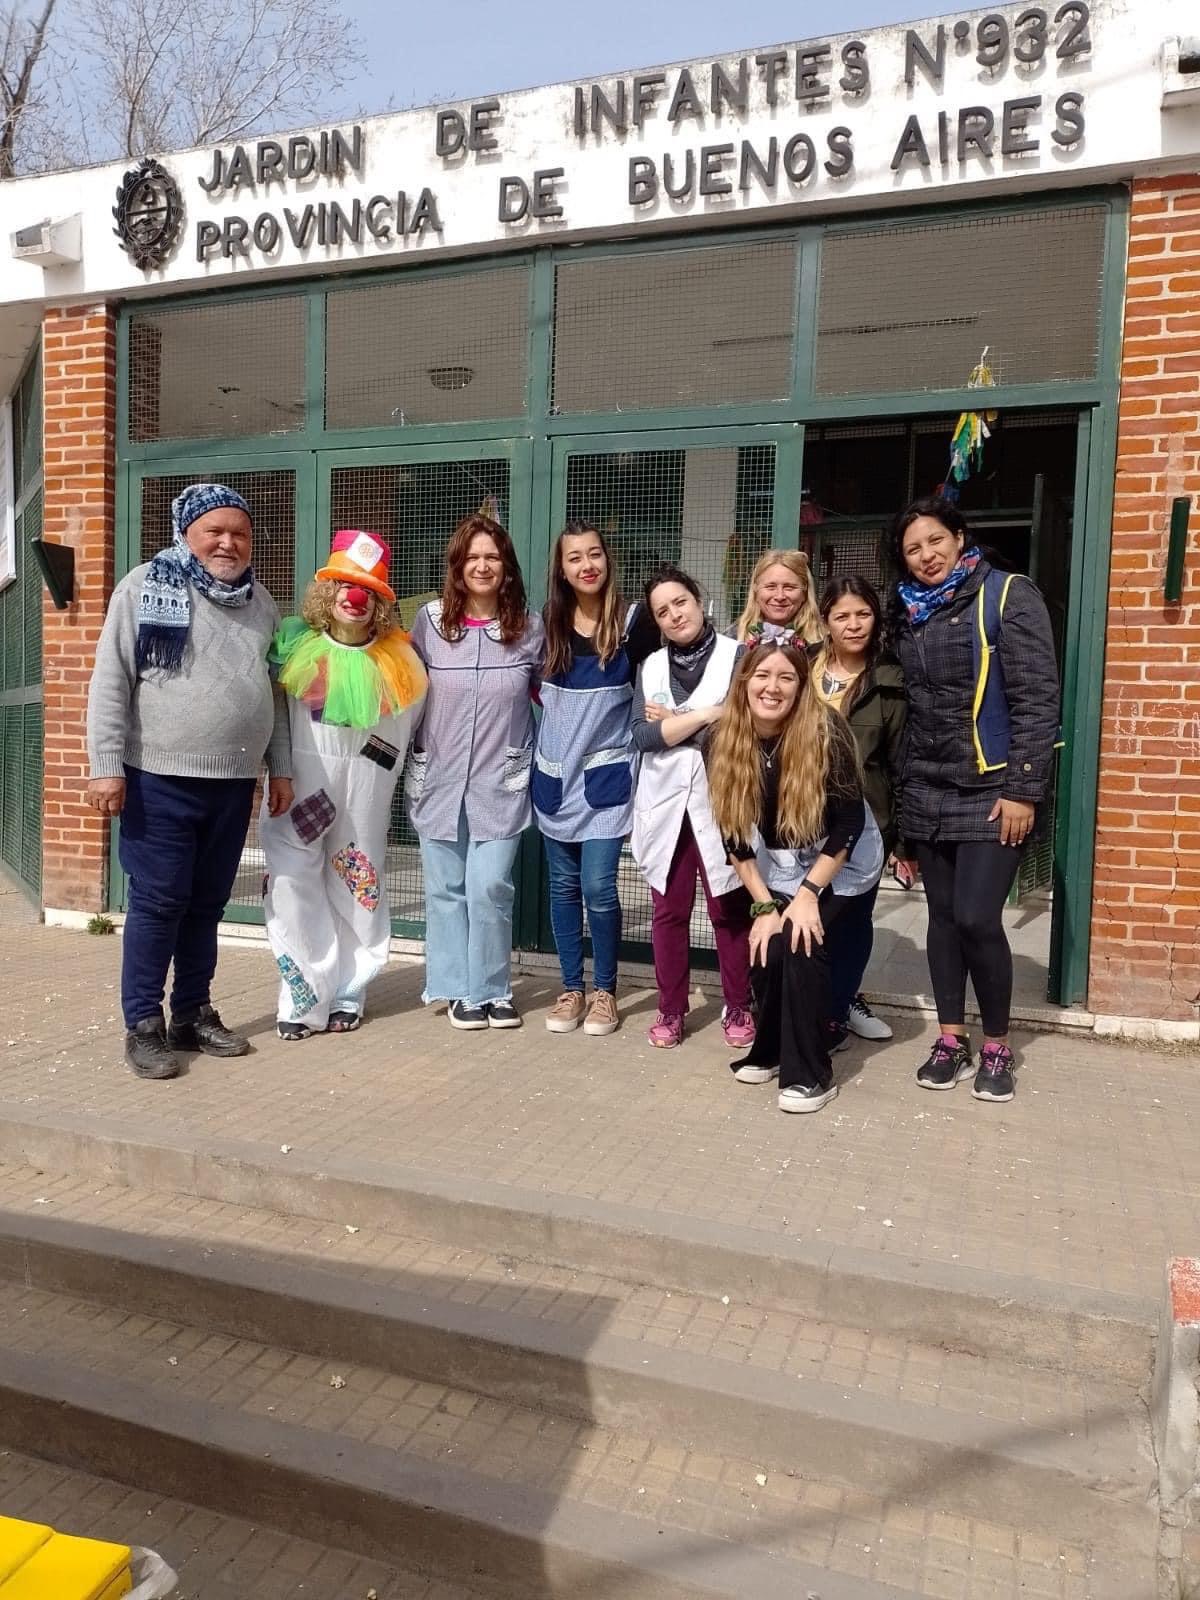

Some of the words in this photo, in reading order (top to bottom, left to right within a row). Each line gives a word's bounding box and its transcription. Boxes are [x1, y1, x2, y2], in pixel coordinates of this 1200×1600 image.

[196, 188, 443, 262] PROVINCIA
[499, 167, 565, 223] DE
[628, 126, 853, 205] BUENOS
[890, 92, 1086, 170] AIRES
[198, 126, 362, 192] JARDIN
[435, 102, 500, 157] DE
[574, 41, 867, 136] INFANTES
